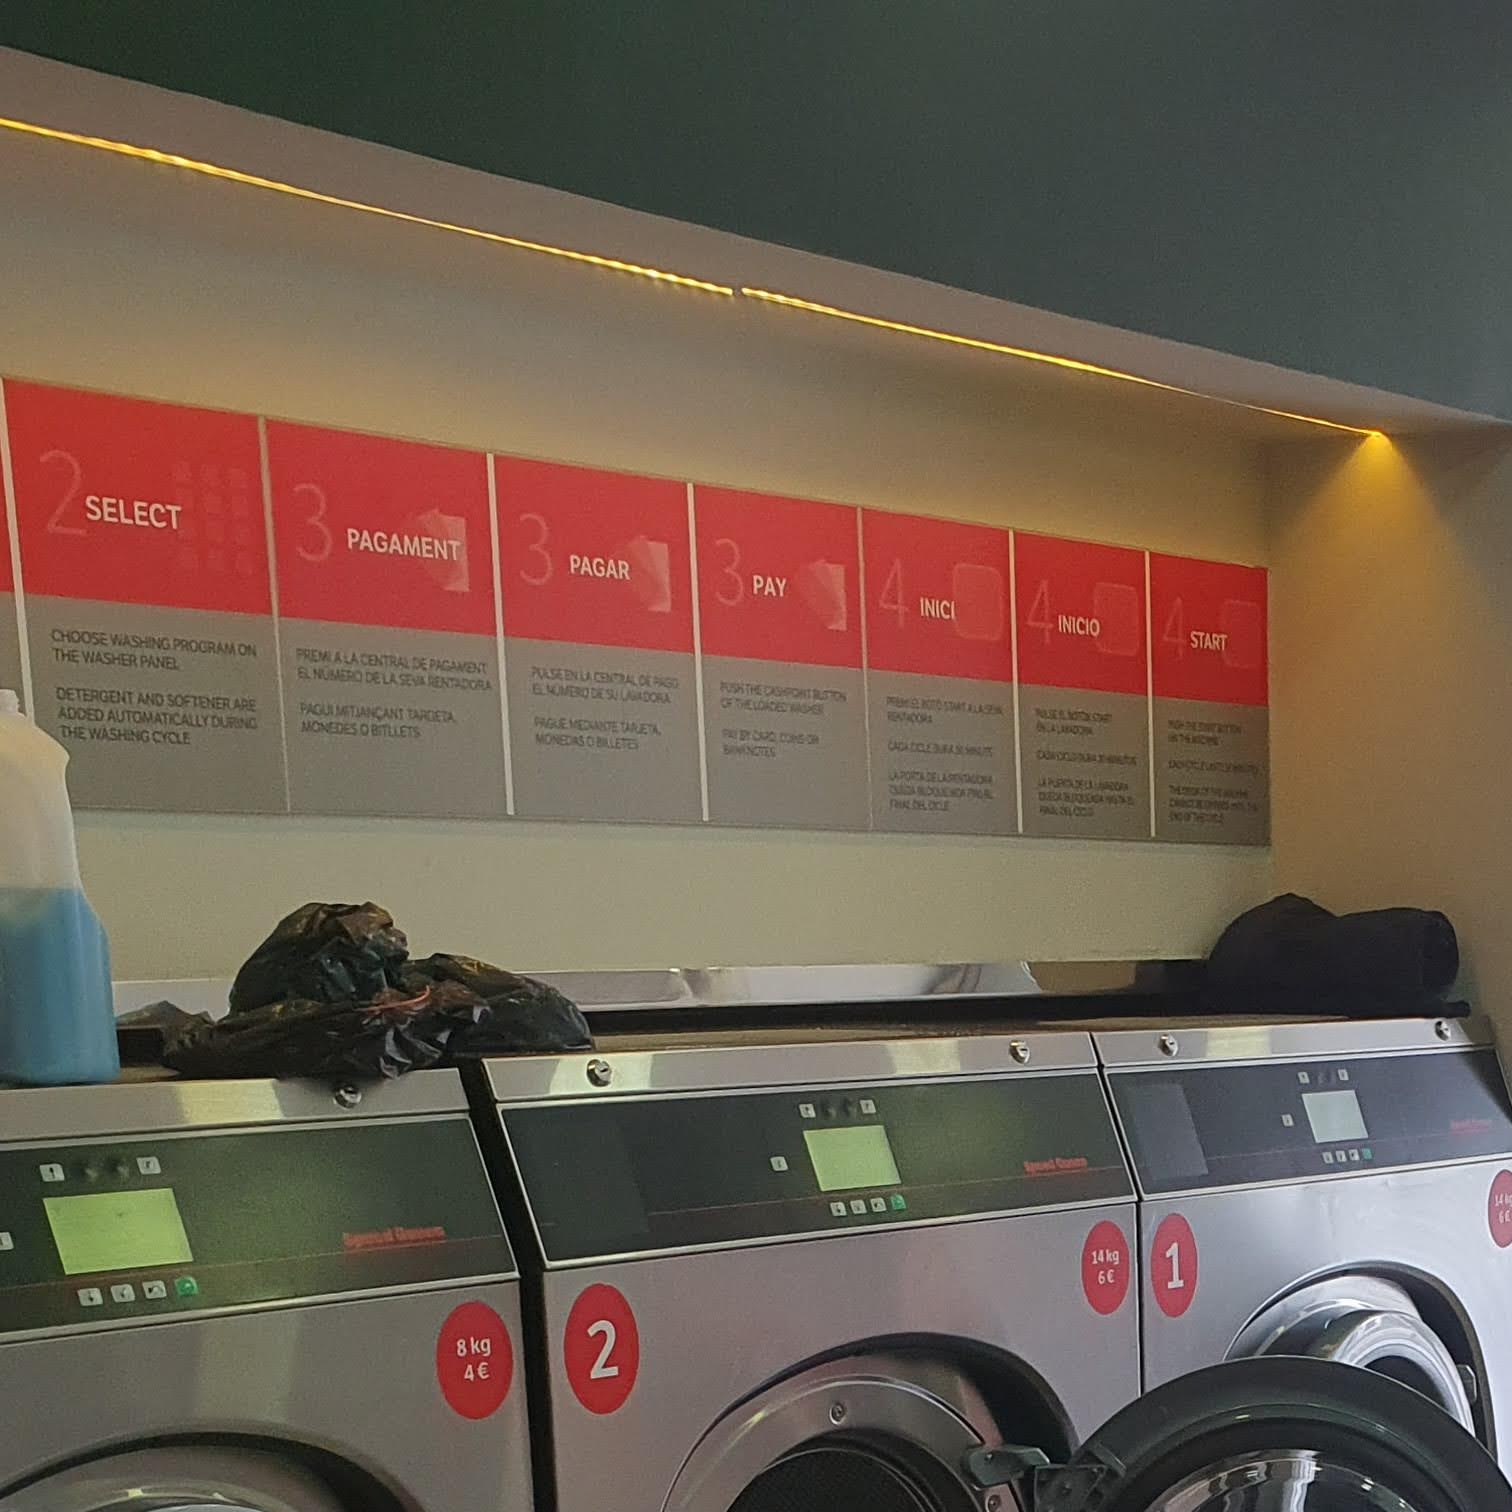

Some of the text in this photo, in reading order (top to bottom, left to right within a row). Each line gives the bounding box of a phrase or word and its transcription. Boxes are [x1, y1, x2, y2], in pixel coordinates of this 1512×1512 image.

[85, 495, 182, 530] SELECT
[347, 528, 462, 561] PAGAMENT
[569, 554, 631, 581] PAGAR
[753, 575, 787, 598] PAY
[919, 597, 956, 621] INICI
[1058, 614, 1100, 638] INICIO
[51, 628, 258, 658] CHOOSE WASHING PROGRAM ON
[1189, 630, 1228, 651] START
[52, 648, 181, 671] THE WASHER PANEL
[56, 686, 257, 713] DETERGENT AND SOFTENER ARE
[57, 706, 259, 730] ADDED AUTOMATICALLY DURING
[59, 726, 192, 746] THE WASHING CYCLE
[1165, 1241, 1184, 1289] 1
[456, 1335, 492, 1361] 8 kg
[585, 1318, 620, 1380] 2
